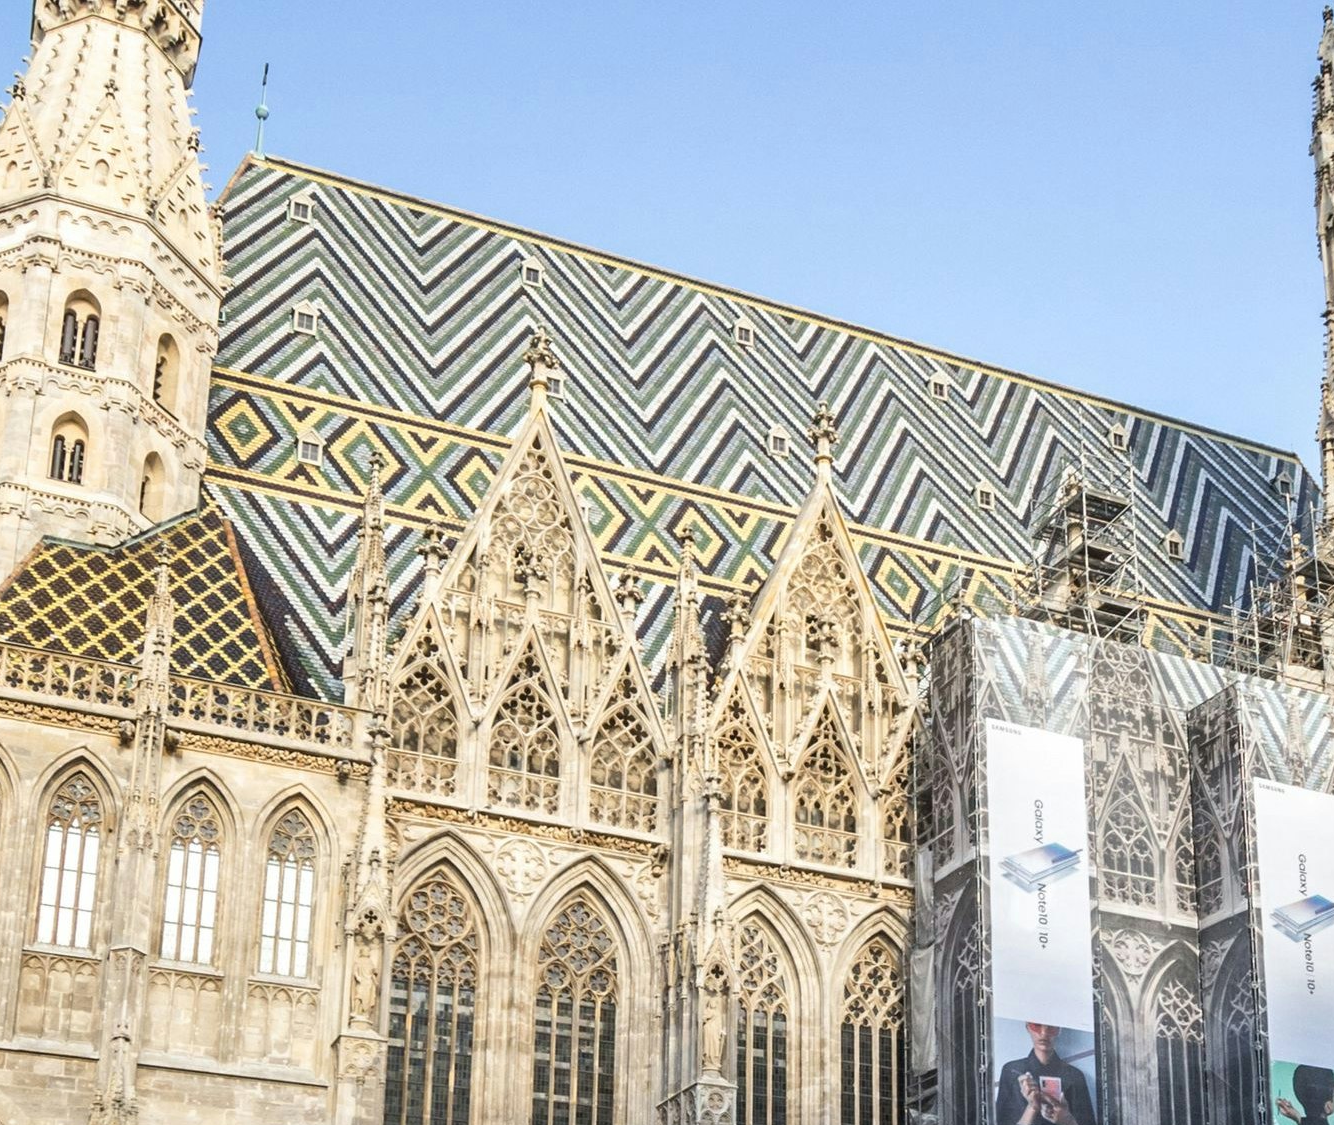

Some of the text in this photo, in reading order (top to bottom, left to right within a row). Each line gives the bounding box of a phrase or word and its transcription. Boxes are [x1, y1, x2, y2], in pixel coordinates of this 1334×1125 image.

[1034, 799, 1044, 844] Galaxy
[1037, 883, 1048, 925] Note10
[1298, 854, 1307, 896] Galaxy
[1304, 933, 1314, 972] Note10
